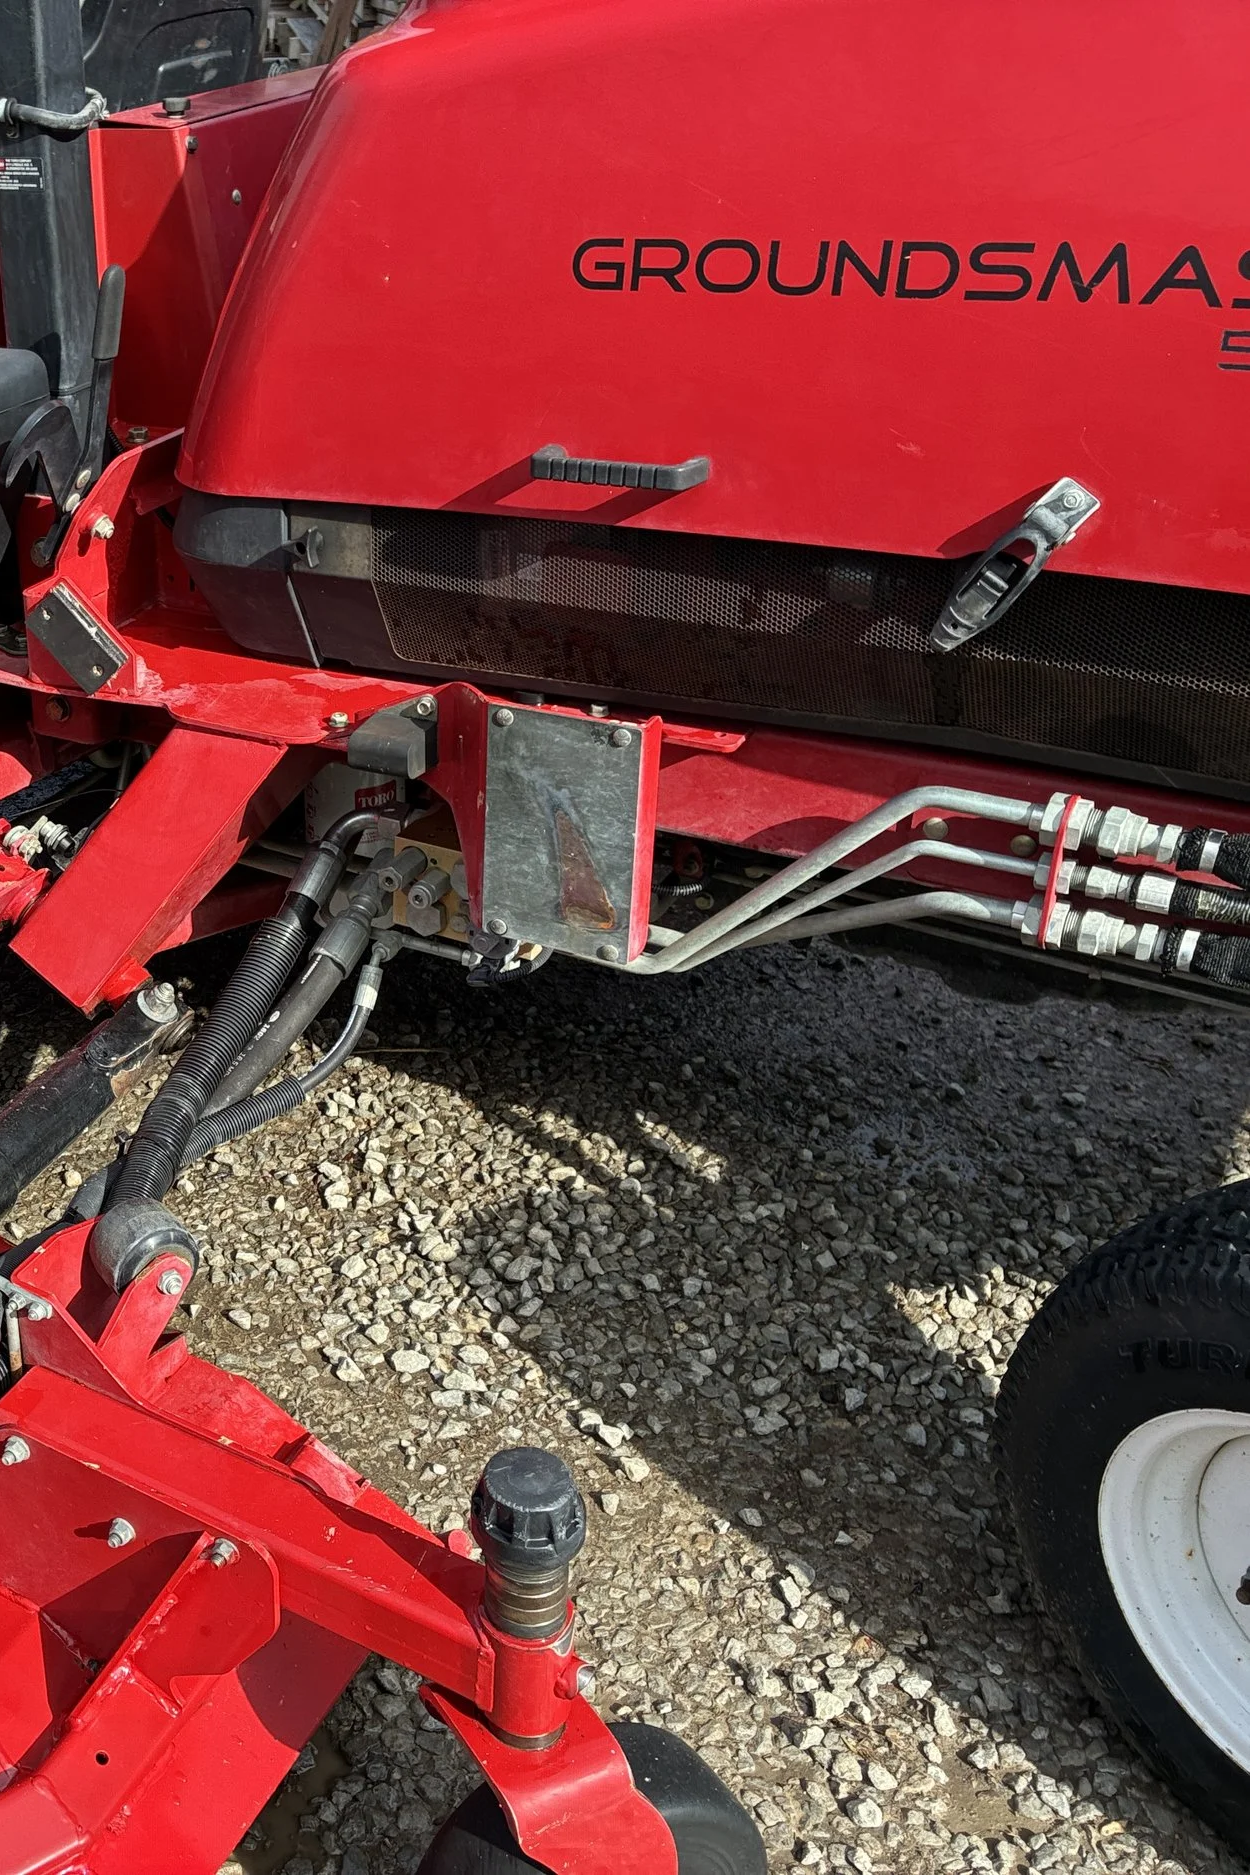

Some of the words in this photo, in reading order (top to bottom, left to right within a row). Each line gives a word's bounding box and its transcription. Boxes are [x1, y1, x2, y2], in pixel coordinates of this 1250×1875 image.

[572, 238, 1250, 309] GROUNDSMA
[358, 790, 394, 808] TORO
[1118, 1337, 1250, 1379] TUR
